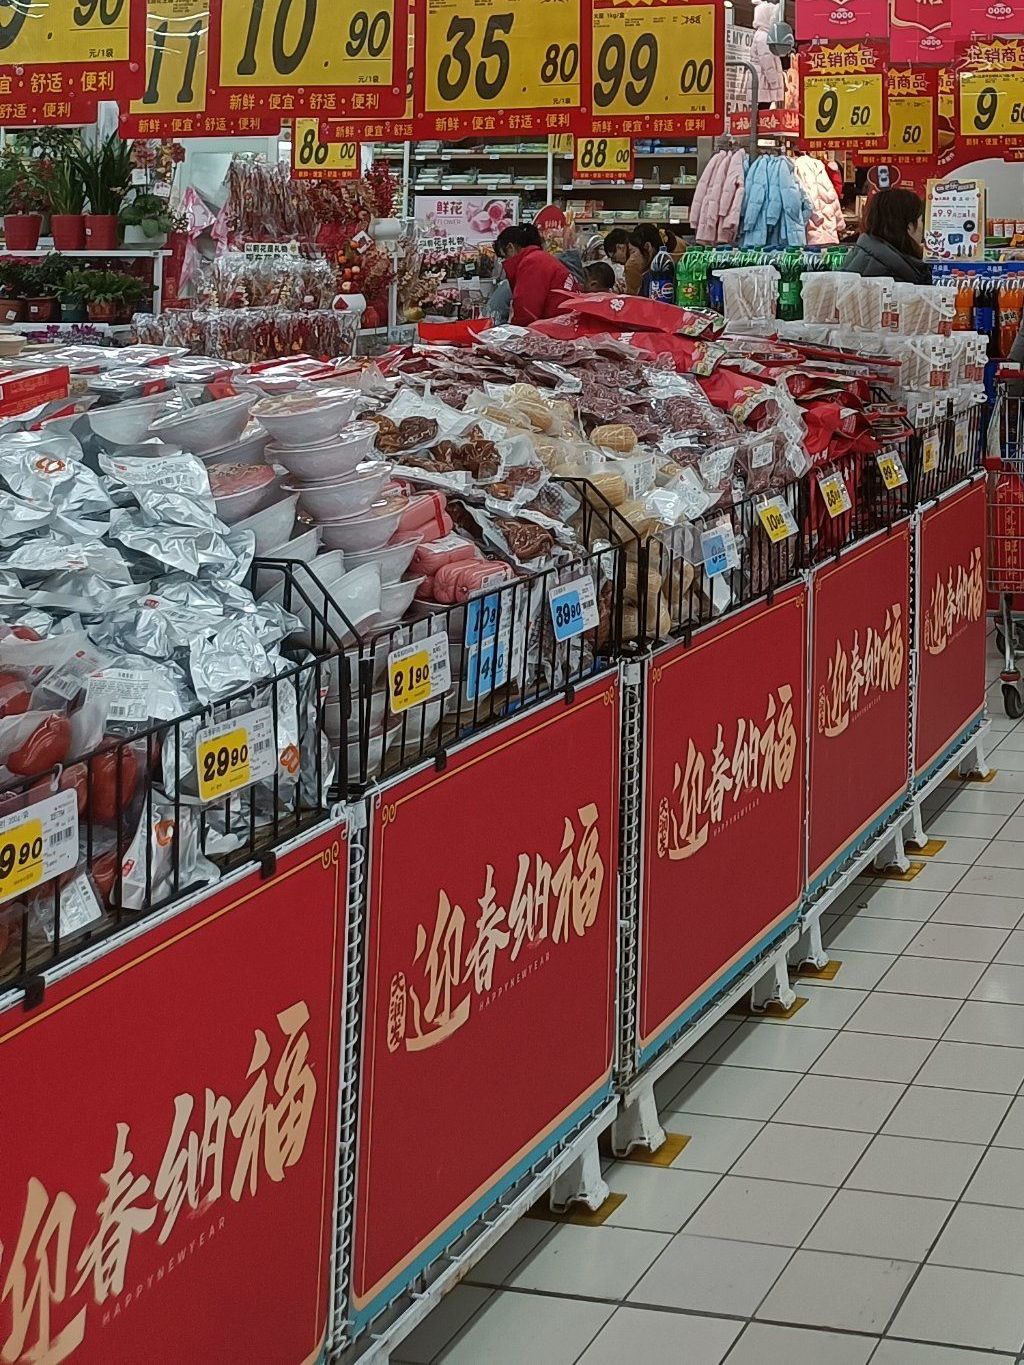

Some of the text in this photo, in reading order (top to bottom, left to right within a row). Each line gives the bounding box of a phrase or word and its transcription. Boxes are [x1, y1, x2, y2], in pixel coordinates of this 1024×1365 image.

[812, 50, 876, 68] 促销商品
[437, 201, 463, 215] 鲜花
[581, 138, 607, 168] 88
[825, 602, 904, 738] 迎春纳福
[666, 683, 798, 861] 迎春纳福
[405, 803, 605, 1053] 迎春纳福
[0, 1000, 318, 1365] 迎春纳福
